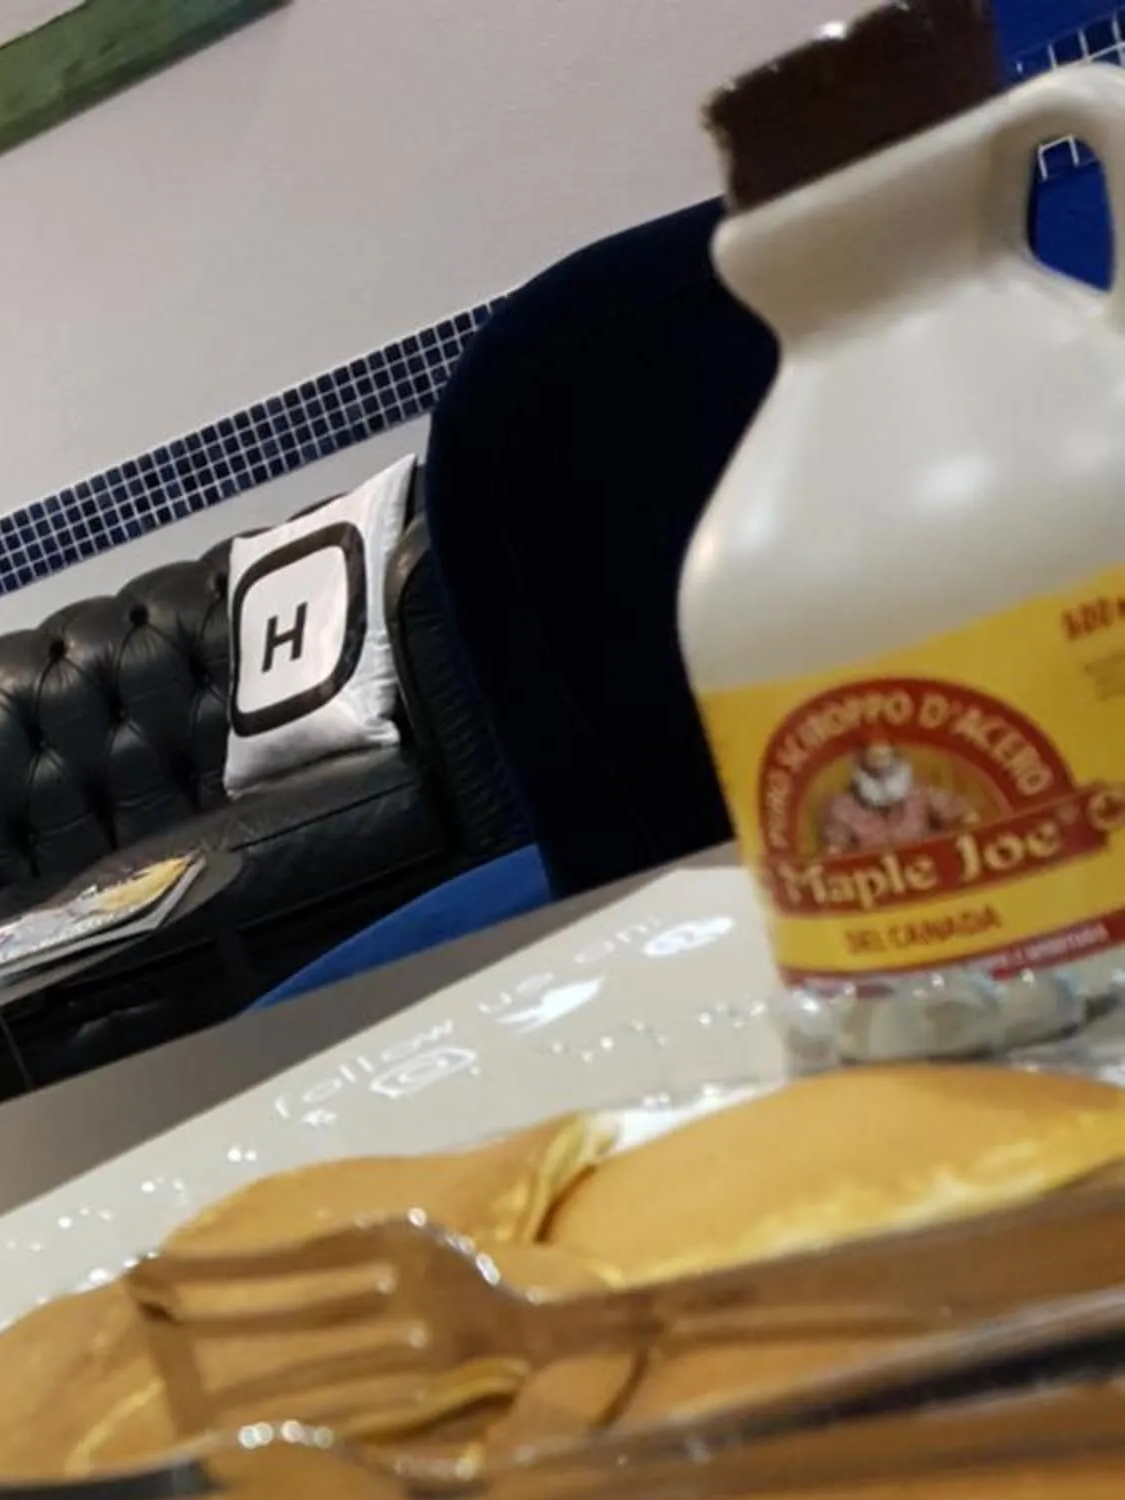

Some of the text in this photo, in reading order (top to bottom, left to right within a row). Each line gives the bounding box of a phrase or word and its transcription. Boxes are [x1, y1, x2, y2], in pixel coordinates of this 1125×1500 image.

[261, 602, 308, 673] H
[779, 820, 1062, 911] Maple Joe
